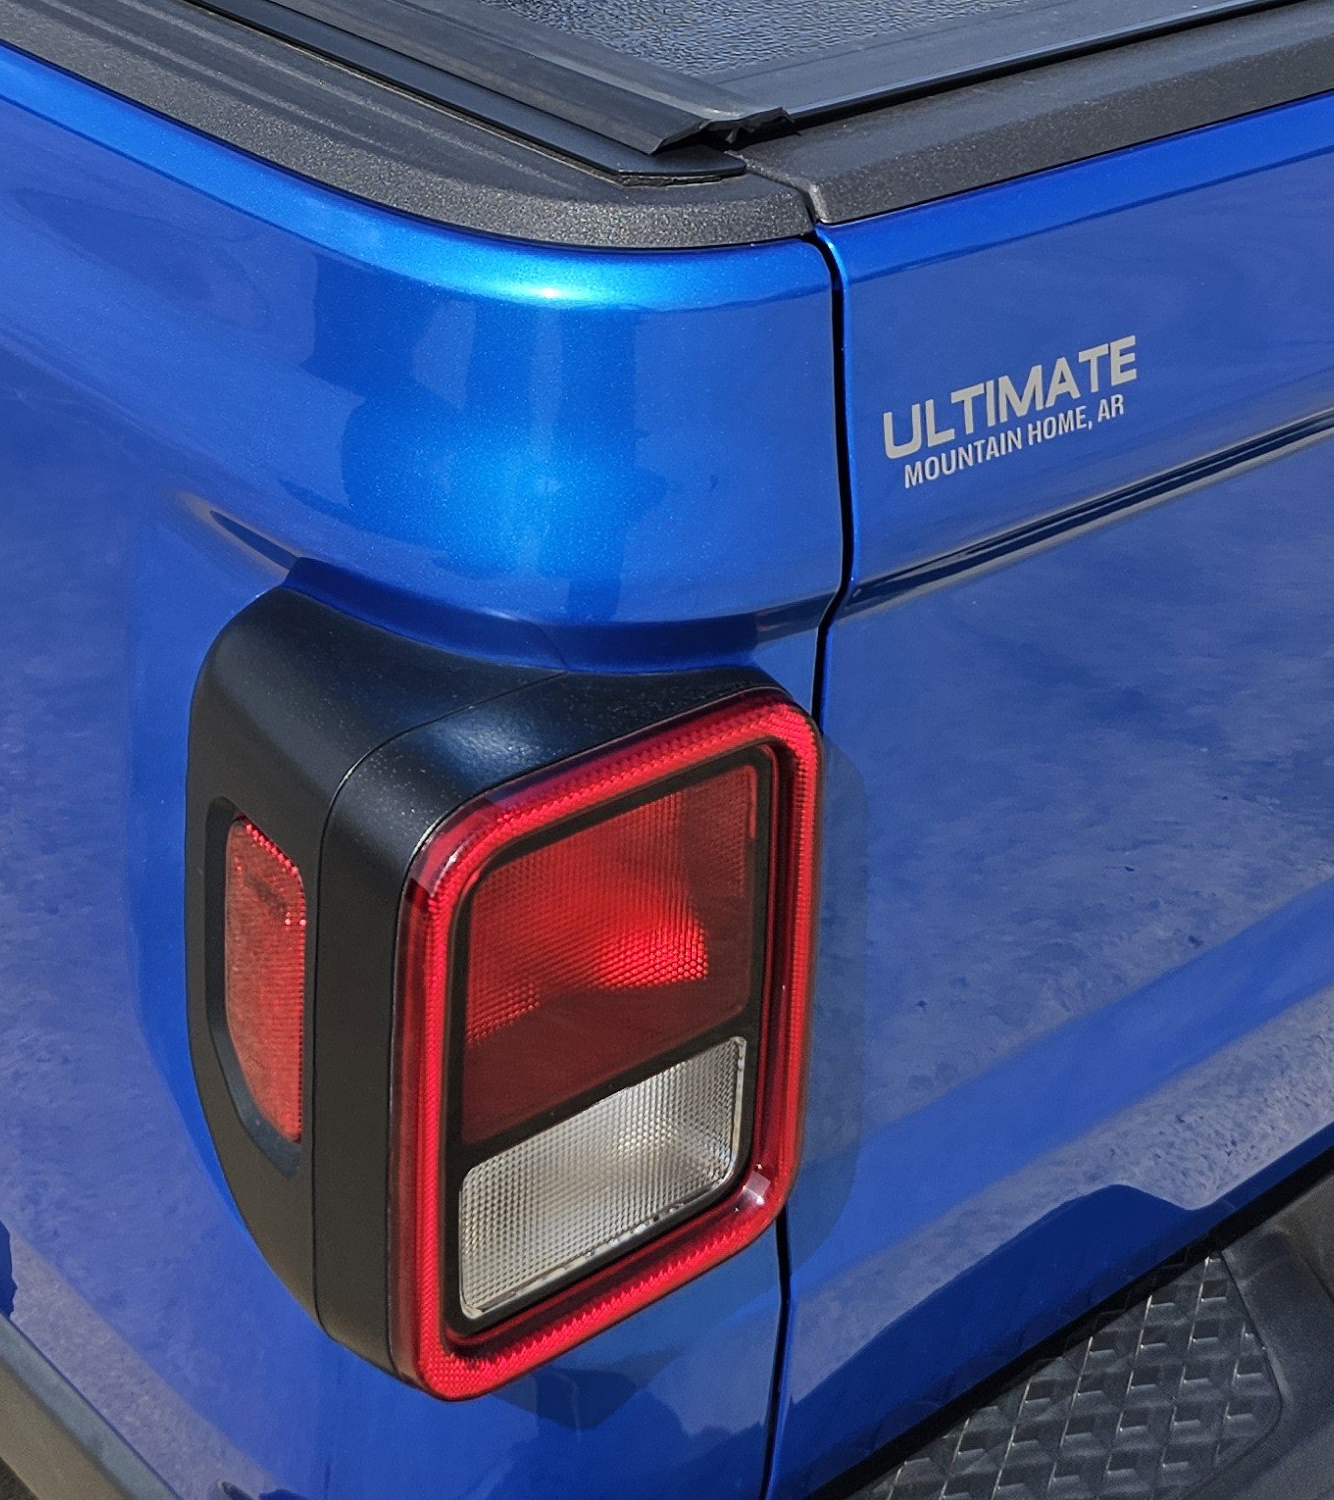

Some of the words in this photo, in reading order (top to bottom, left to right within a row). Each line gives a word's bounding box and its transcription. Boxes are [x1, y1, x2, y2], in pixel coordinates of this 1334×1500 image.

[882, 334, 1138, 460] ULTIMATE
[903, 426, 1023, 490] MOUNTAIN
[1027, 404, 1093, 447] HOME,
[1097, 392, 1125, 424] AR
